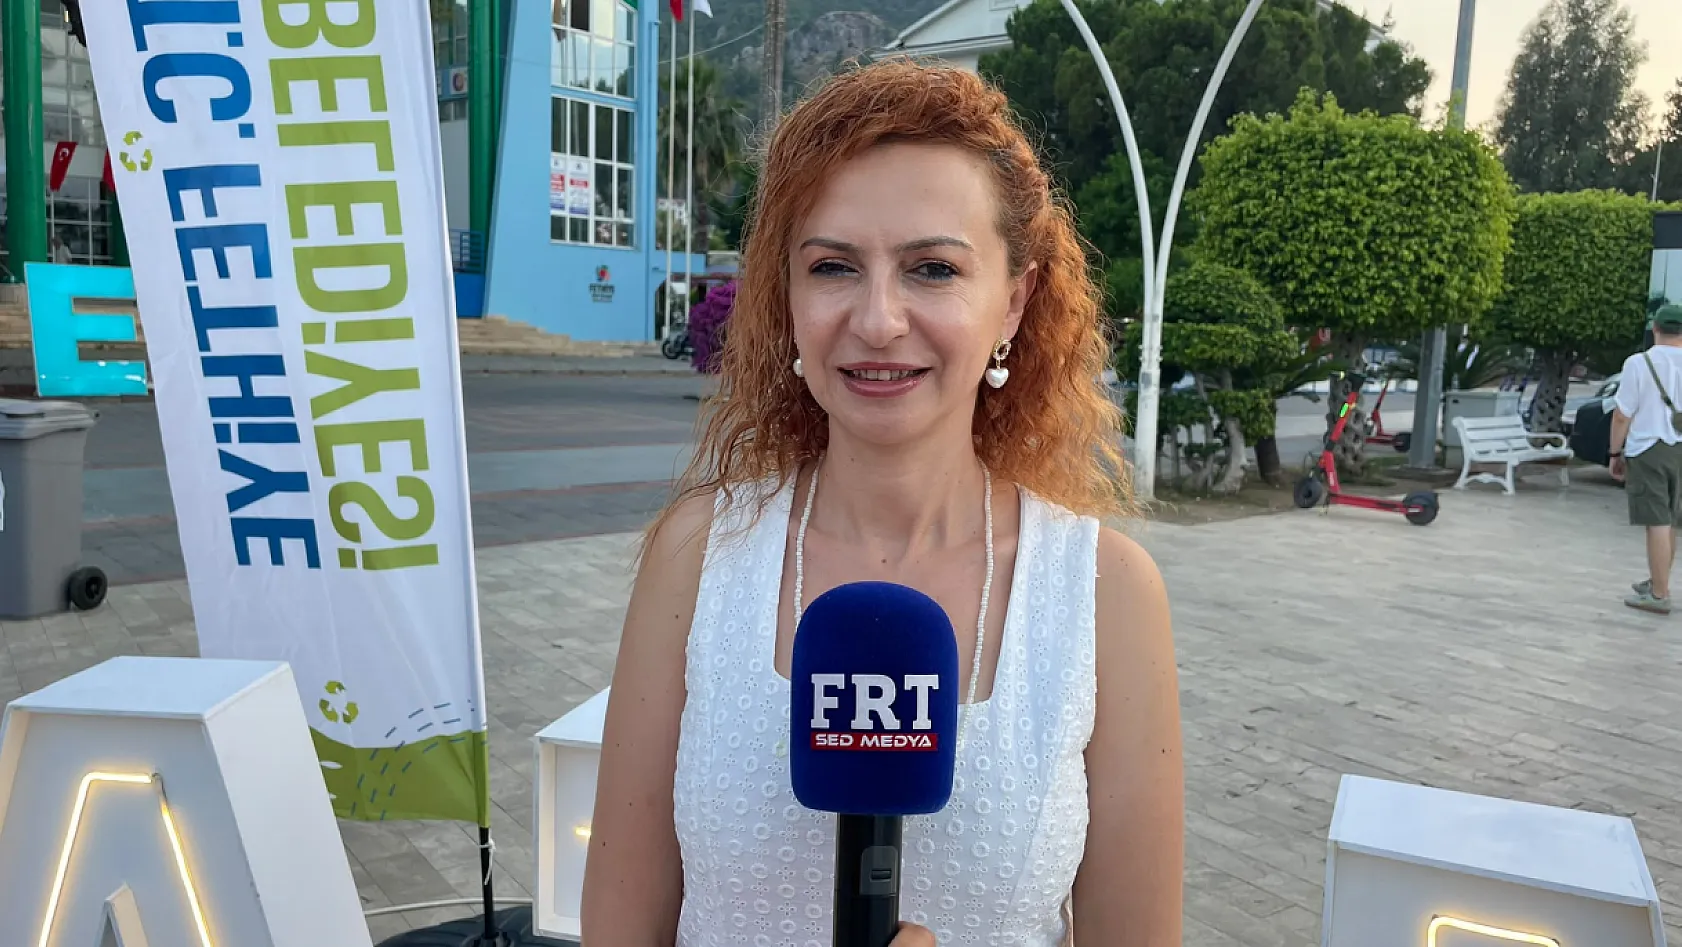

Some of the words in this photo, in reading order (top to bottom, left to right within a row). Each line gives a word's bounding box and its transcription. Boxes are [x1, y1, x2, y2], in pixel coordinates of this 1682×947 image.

[810, 673, 940, 730] FRT
[815, 733, 854, 747] SED
[859, 734, 932, 748] MEDYA
